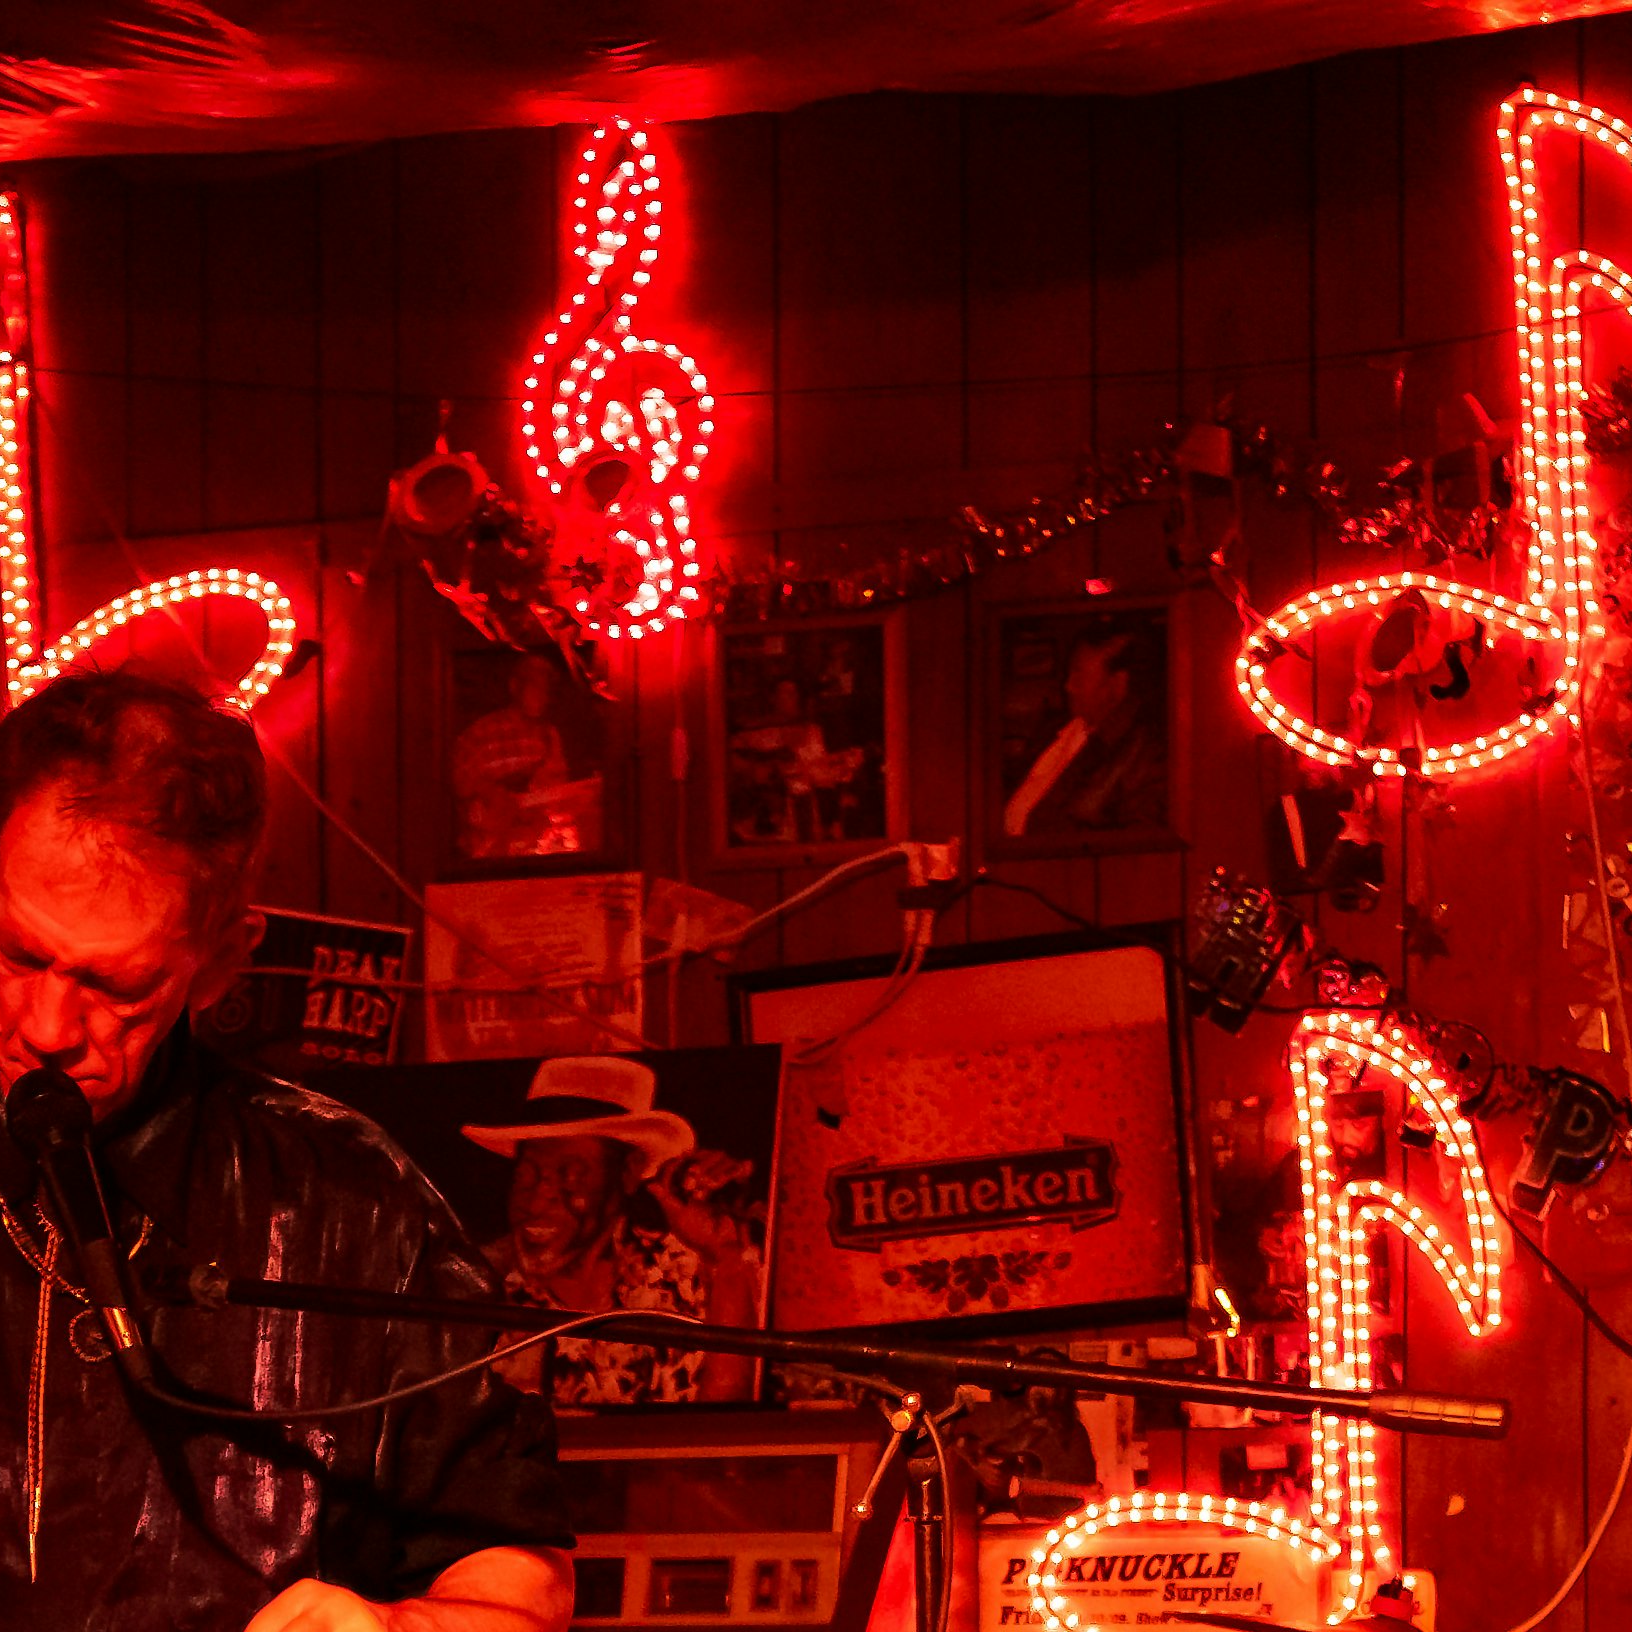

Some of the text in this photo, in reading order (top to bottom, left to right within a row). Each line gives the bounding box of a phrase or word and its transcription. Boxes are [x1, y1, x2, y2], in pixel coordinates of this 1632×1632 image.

[851, 1165, 1100, 1227] Heineken
[1002, 1551, 1240, 1585] PKNUCKLE
[1162, 1582, 1264, 1607] Surprise!
